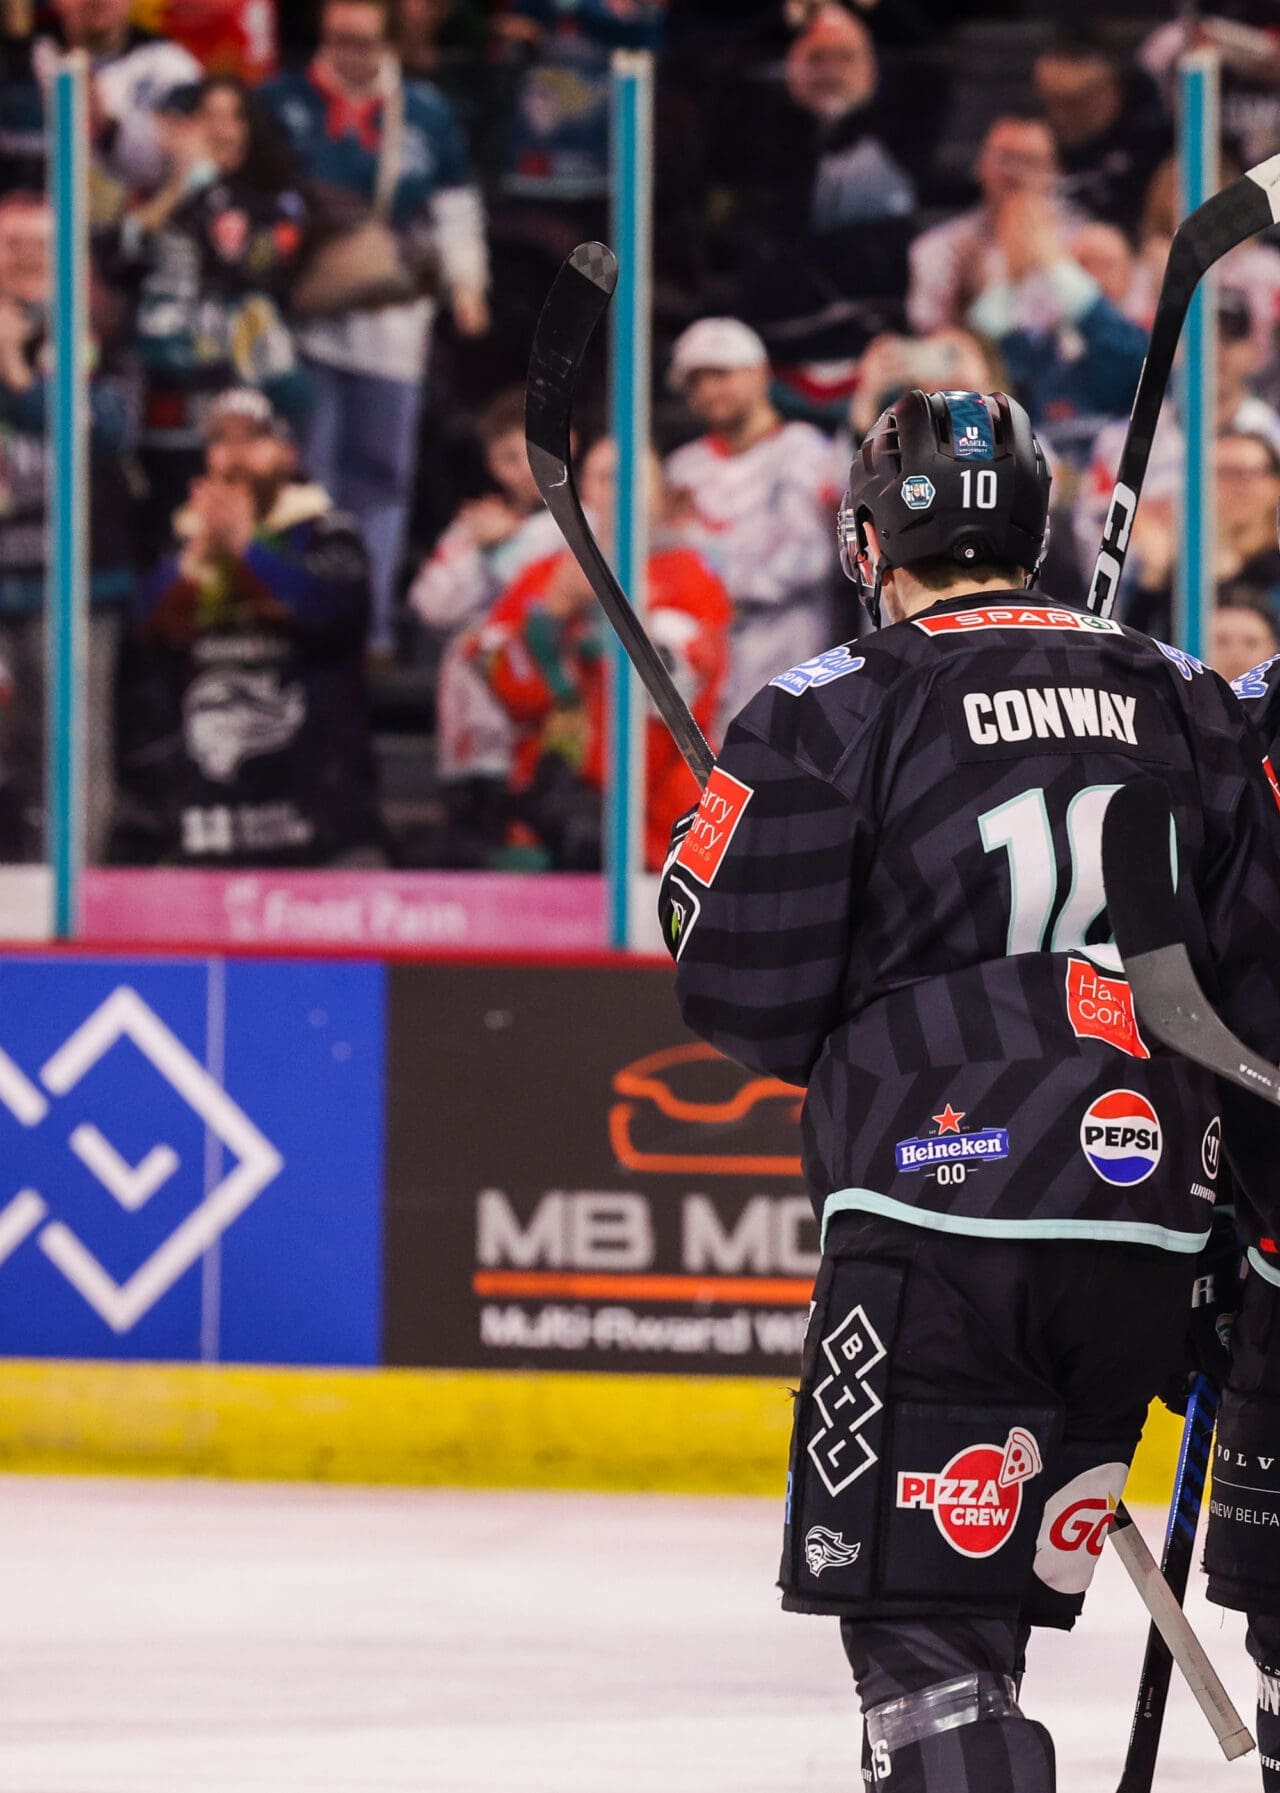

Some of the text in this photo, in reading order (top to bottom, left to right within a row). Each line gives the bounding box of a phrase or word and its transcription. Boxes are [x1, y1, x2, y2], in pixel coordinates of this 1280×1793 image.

[960, 470, 998, 510] 10
[955, 610, 1077, 627] SPAR
[962, 687, 1138, 745] CONWAY
[701, 786, 734, 825] arry
[691, 812, 724, 850] orry
[901, 1136, 1002, 1166] Heineken
[1084, 1125, 1159, 1151] PEPSI
[937, 1163, 967, 1185] 0.0
[476, 1189, 656, 1270] MB
[901, 1477, 1000, 1507] PIZZA
[950, 1507, 1010, 1527] CREW
